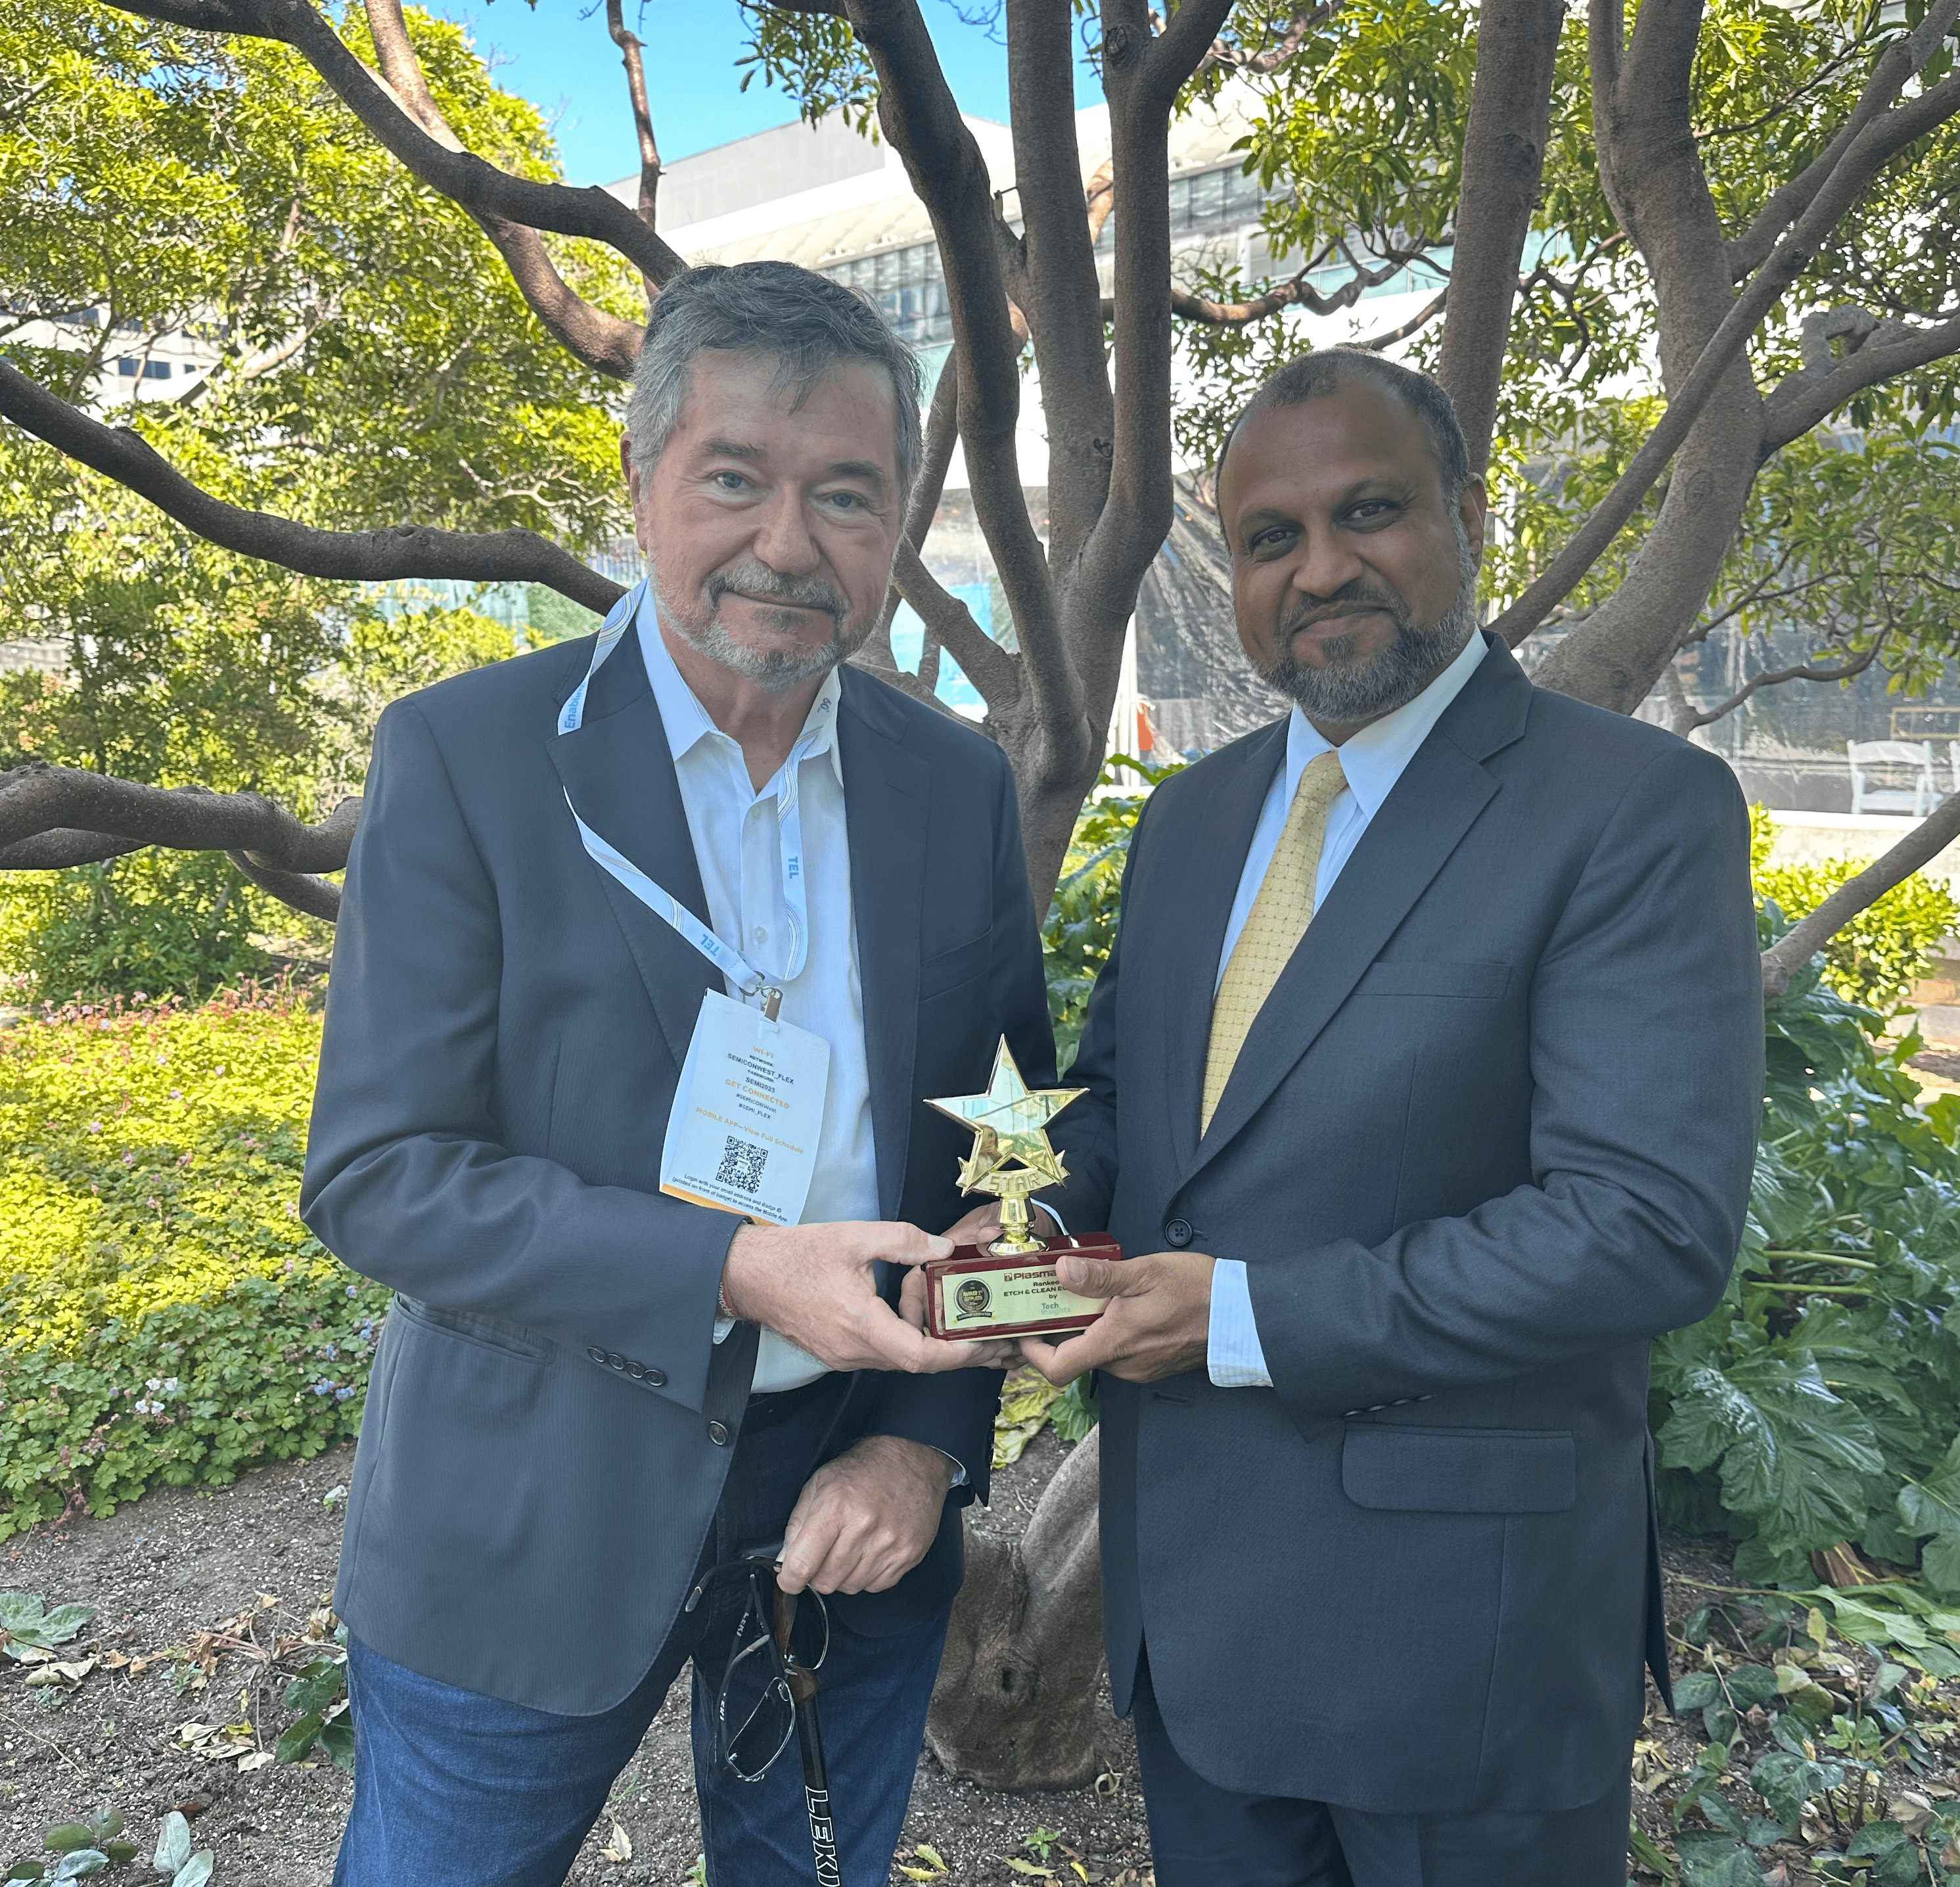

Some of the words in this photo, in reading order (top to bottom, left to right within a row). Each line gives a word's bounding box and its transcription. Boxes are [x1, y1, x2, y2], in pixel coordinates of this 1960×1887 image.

[788, 855, 800, 879] TEL
[700, 934, 720, 957] TEL
[727, 1053, 794, 1085] SEMICONWEST_FLEX
[725, 1078, 741, 1089] GET
[742, 1085, 790, 1109] CONNECTED
[739, 1103, 771, 1120] #SEMI_FLEX
[696, 1106, 723, 1122] MOBILE
[761, 1133, 774, 1142] Full
[774, 1138, 804, 1154] Schedule
[684, 1173, 698, 1183] Login
[733, 1193, 752, 1202] address
[762, 1202, 776, 1211] Badge
[990, 1172, 1041, 1191] STAR
[698, 1185, 710, 1194] front
[738, 1201, 754, 1210] access
[762, 1209, 777, 1218] Mobile
[1014, 1269, 1057, 1281] Plasma
[1041, 1302, 1059, 1310] Tech
[805, 1785, 840, 1887] LEKI
